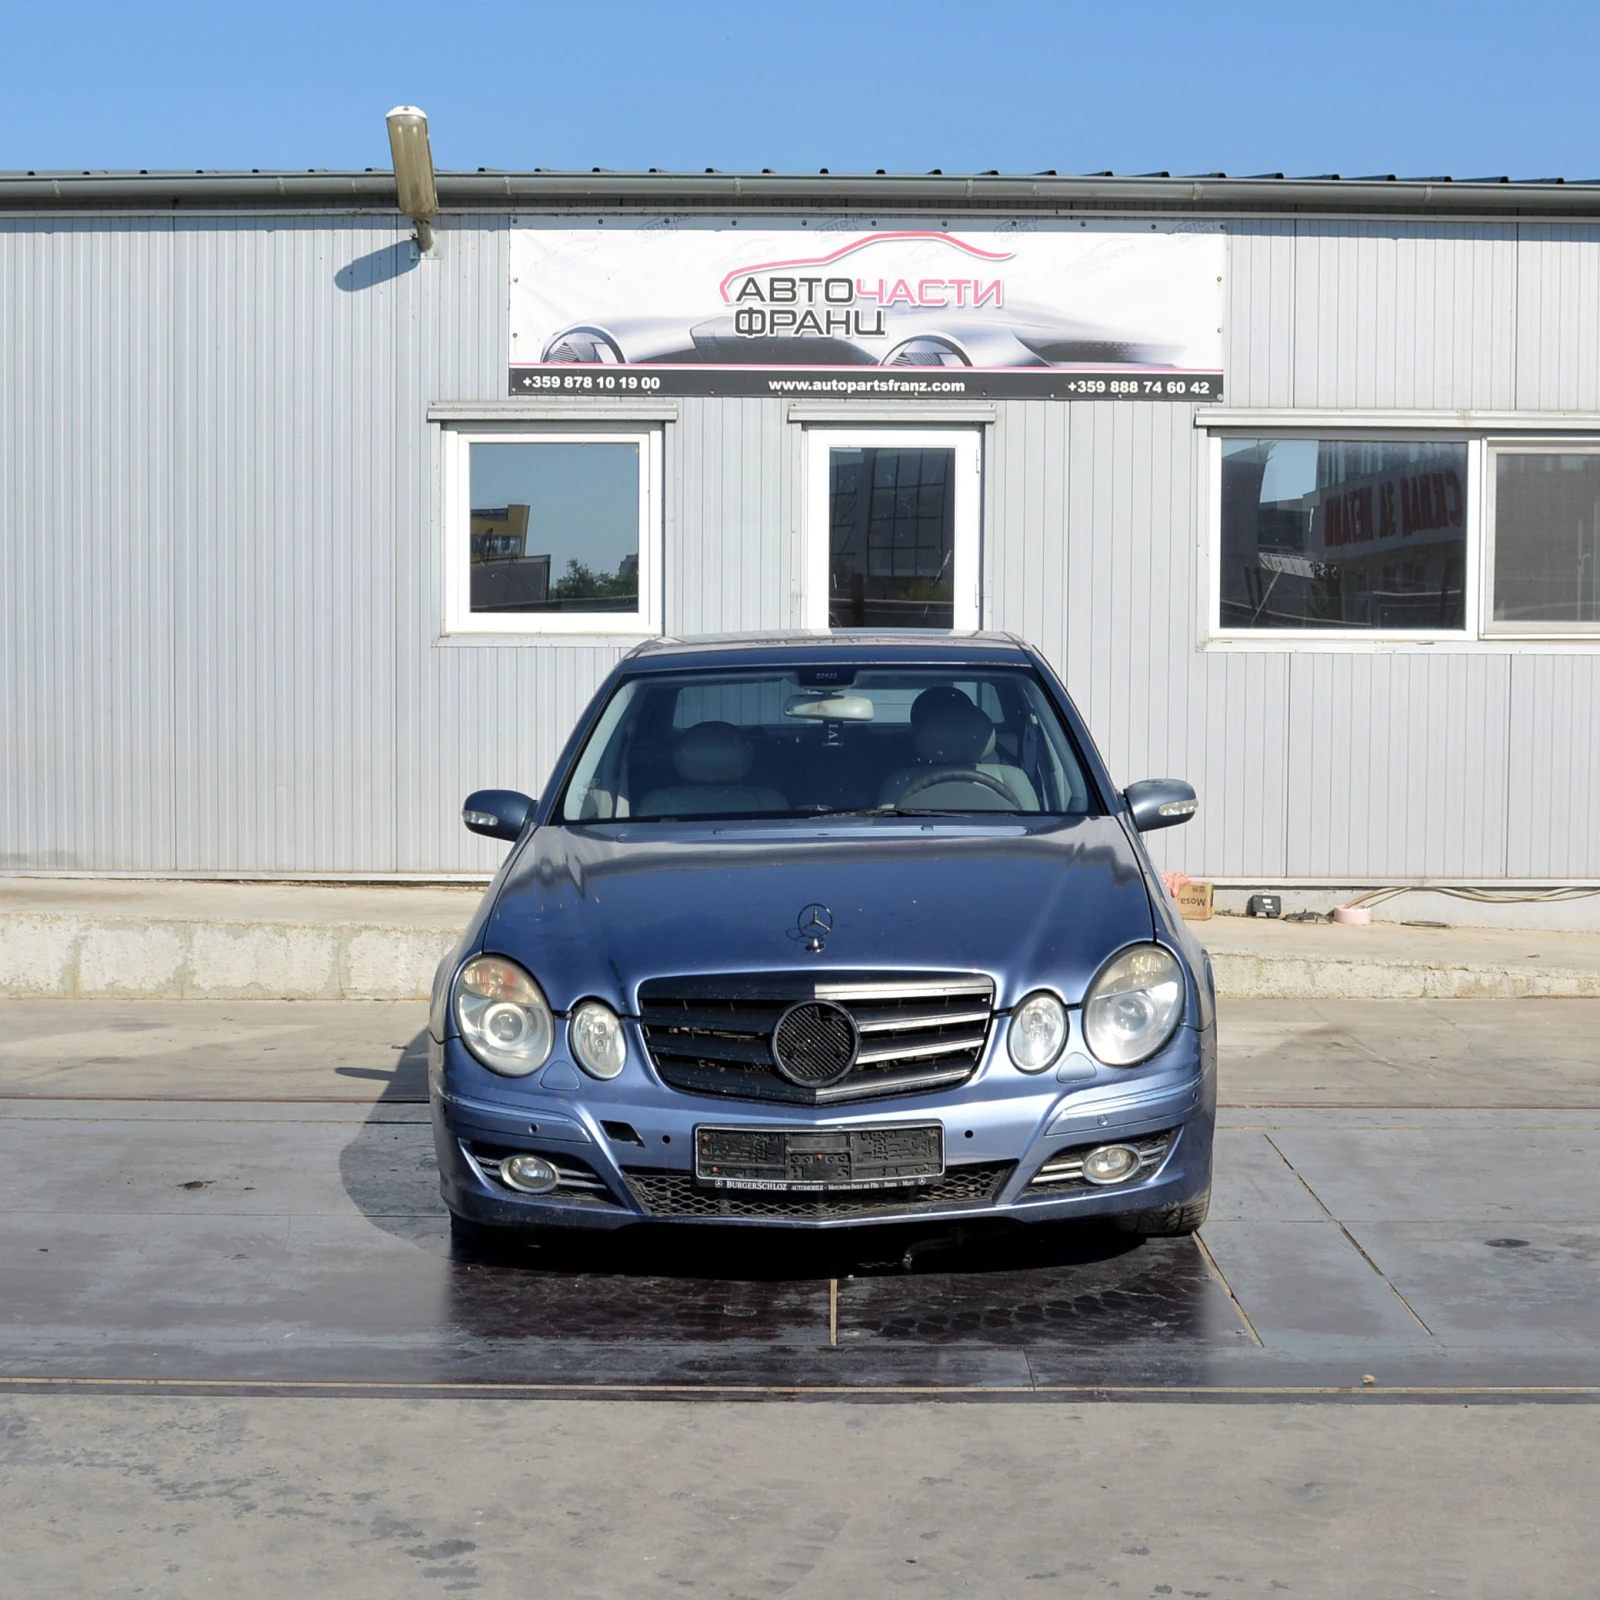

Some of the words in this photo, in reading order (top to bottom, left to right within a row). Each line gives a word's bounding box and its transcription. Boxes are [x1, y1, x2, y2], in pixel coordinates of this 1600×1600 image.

[736, 278, 1001, 307] АВТОЧАСТИ
[735, 307, 885, 337] ФРАНЦ
[523, 376, 560, 388] +359
[564, 376, 592, 388] 878
[597, 377, 615, 388] 10
[619, 377, 637, 389] 19
[641, 377, 660, 389] 00
[768, 379, 966, 394] www.autopartsfranz.com
[1068, 381, 1105, 393] +359
[1110, 381, 1138, 393] 888
[1143, 381, 1162, 393] 74
[1167, 382, 1185, 393] 60
[1190, 382, 1209, 394] 42
